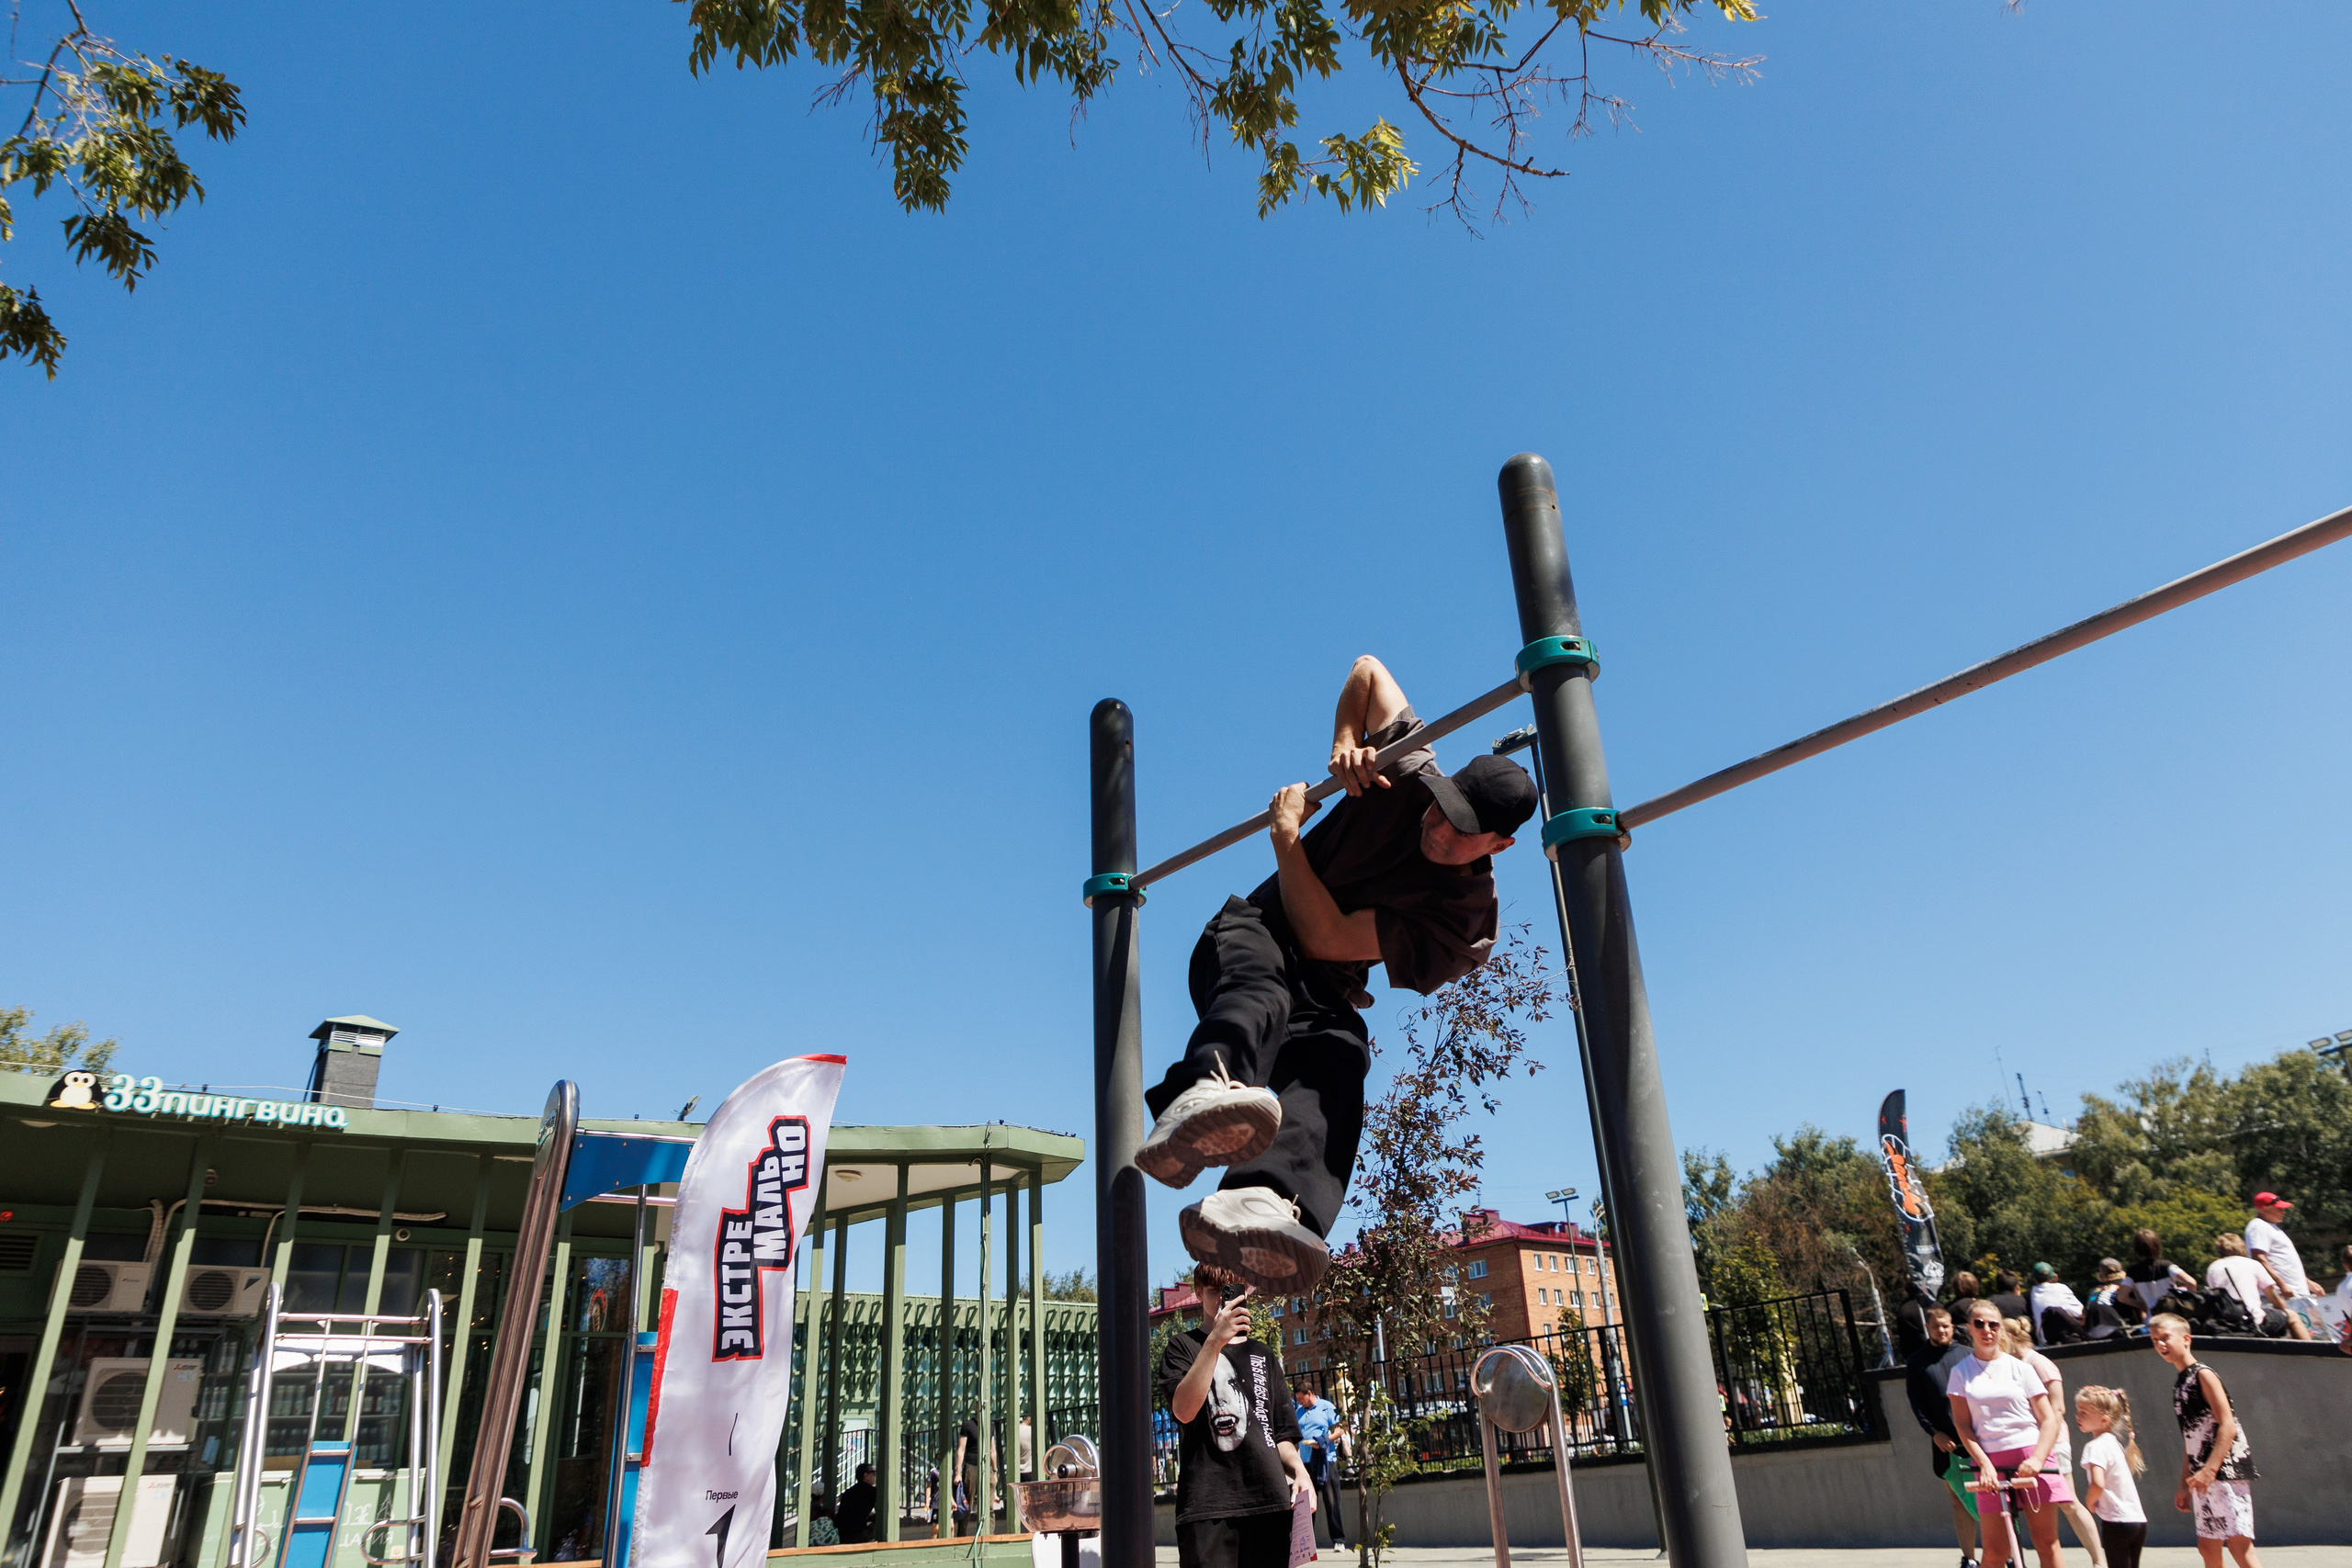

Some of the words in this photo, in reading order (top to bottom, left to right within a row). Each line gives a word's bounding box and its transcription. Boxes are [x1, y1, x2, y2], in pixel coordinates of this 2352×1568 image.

[776, 1125, 806, 1183] НО
[753, 1156, 786, 1260] МАЛЬ
[721, 1221, 754, 1350] ЭКСТРЕ
[705, 1489, 739, 1504] Первые
